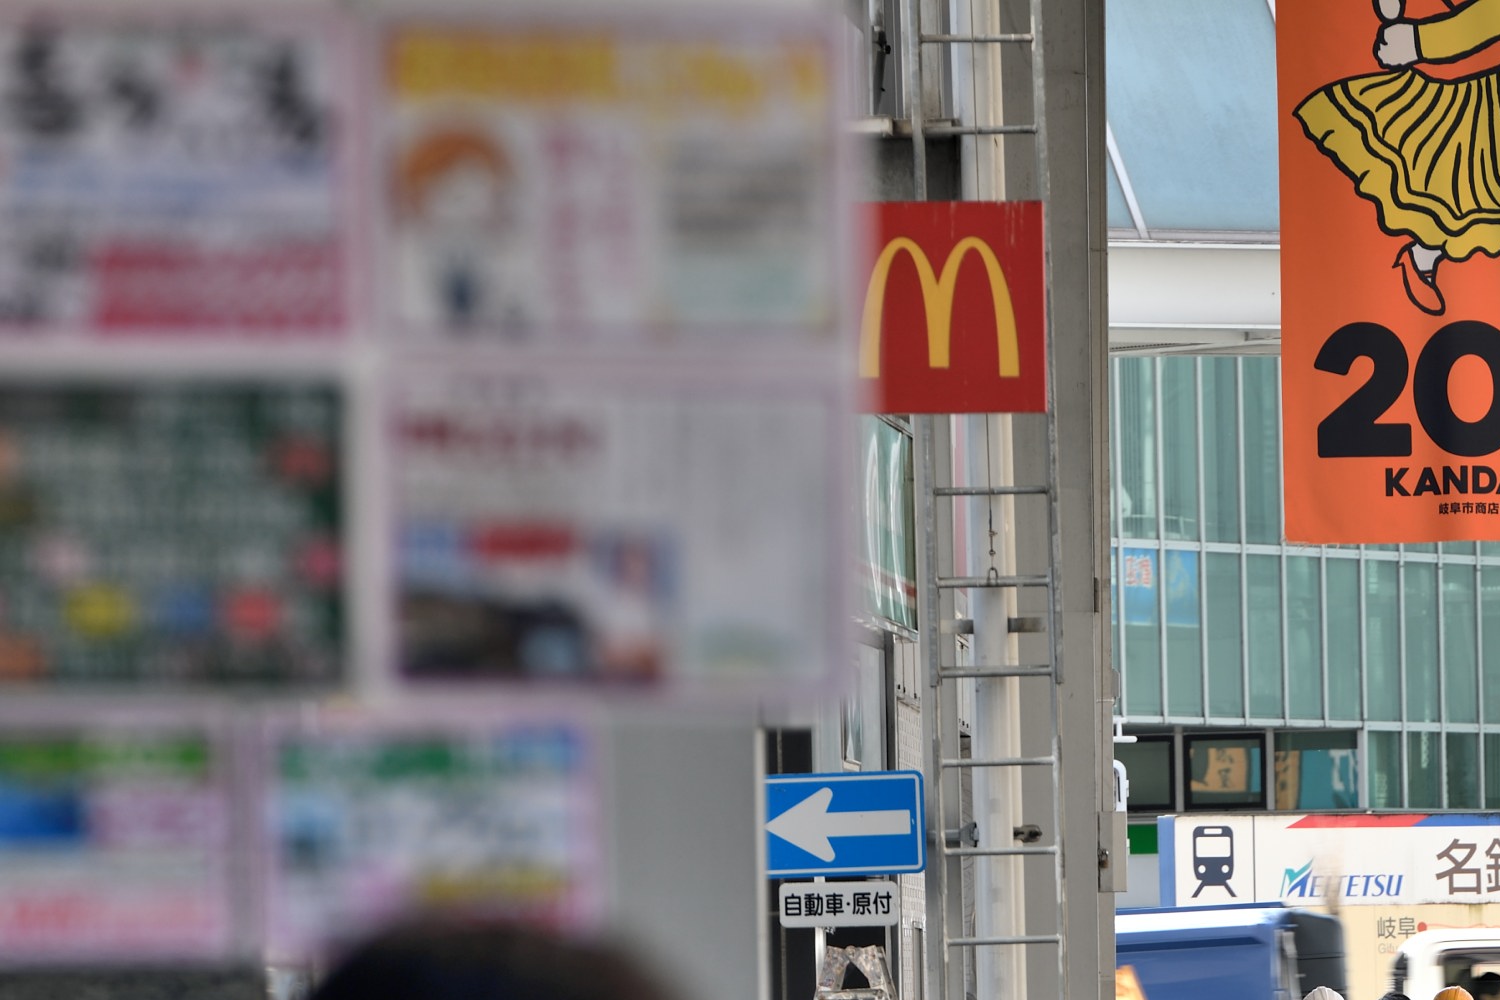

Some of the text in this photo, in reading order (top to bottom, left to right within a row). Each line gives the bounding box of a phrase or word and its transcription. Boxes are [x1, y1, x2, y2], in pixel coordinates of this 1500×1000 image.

[784, 891, 892, 917] 自動車・原付
[1377, 917, 1416, 939] 岐阜
